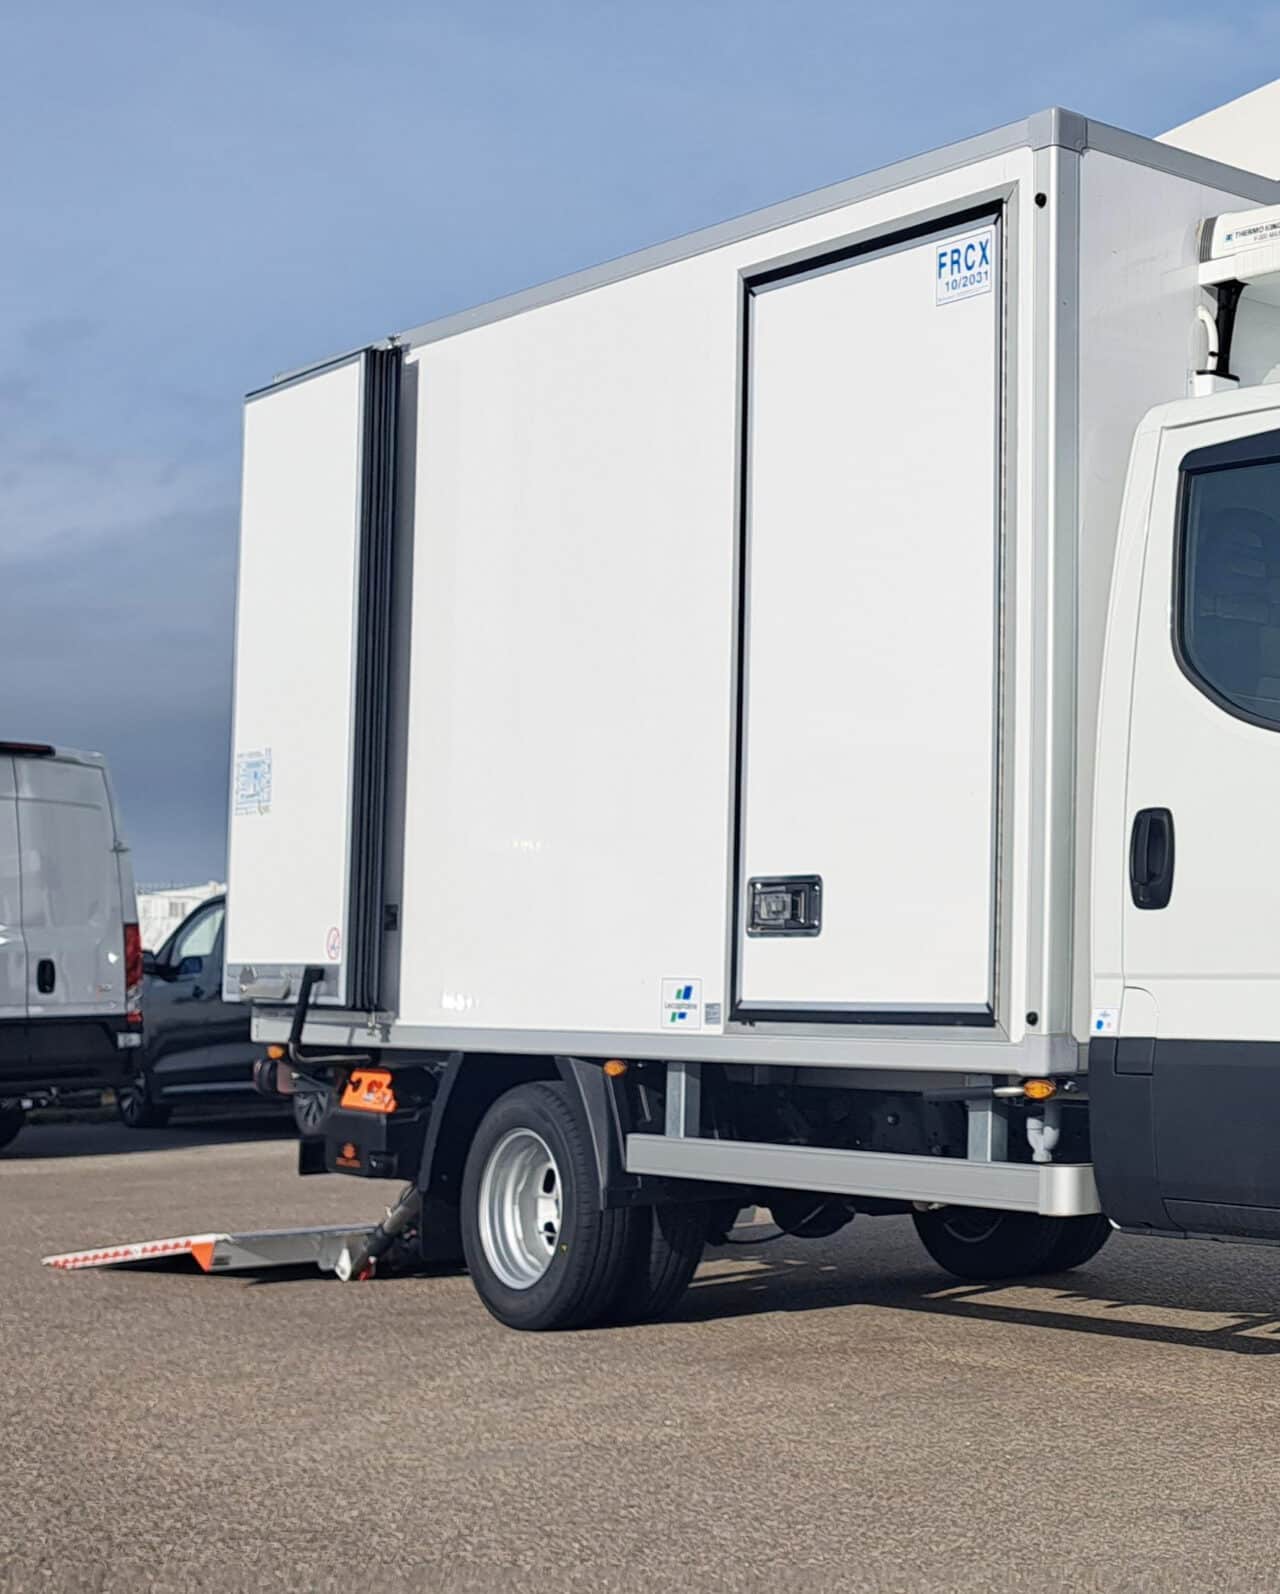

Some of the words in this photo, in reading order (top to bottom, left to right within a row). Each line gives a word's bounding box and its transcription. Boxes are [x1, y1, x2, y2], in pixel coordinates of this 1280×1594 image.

[1235, 224, 1265, 239] THERMO
[938, 239, 989, 280] FRCX
[945, 270, 988, 292] 10/2031
